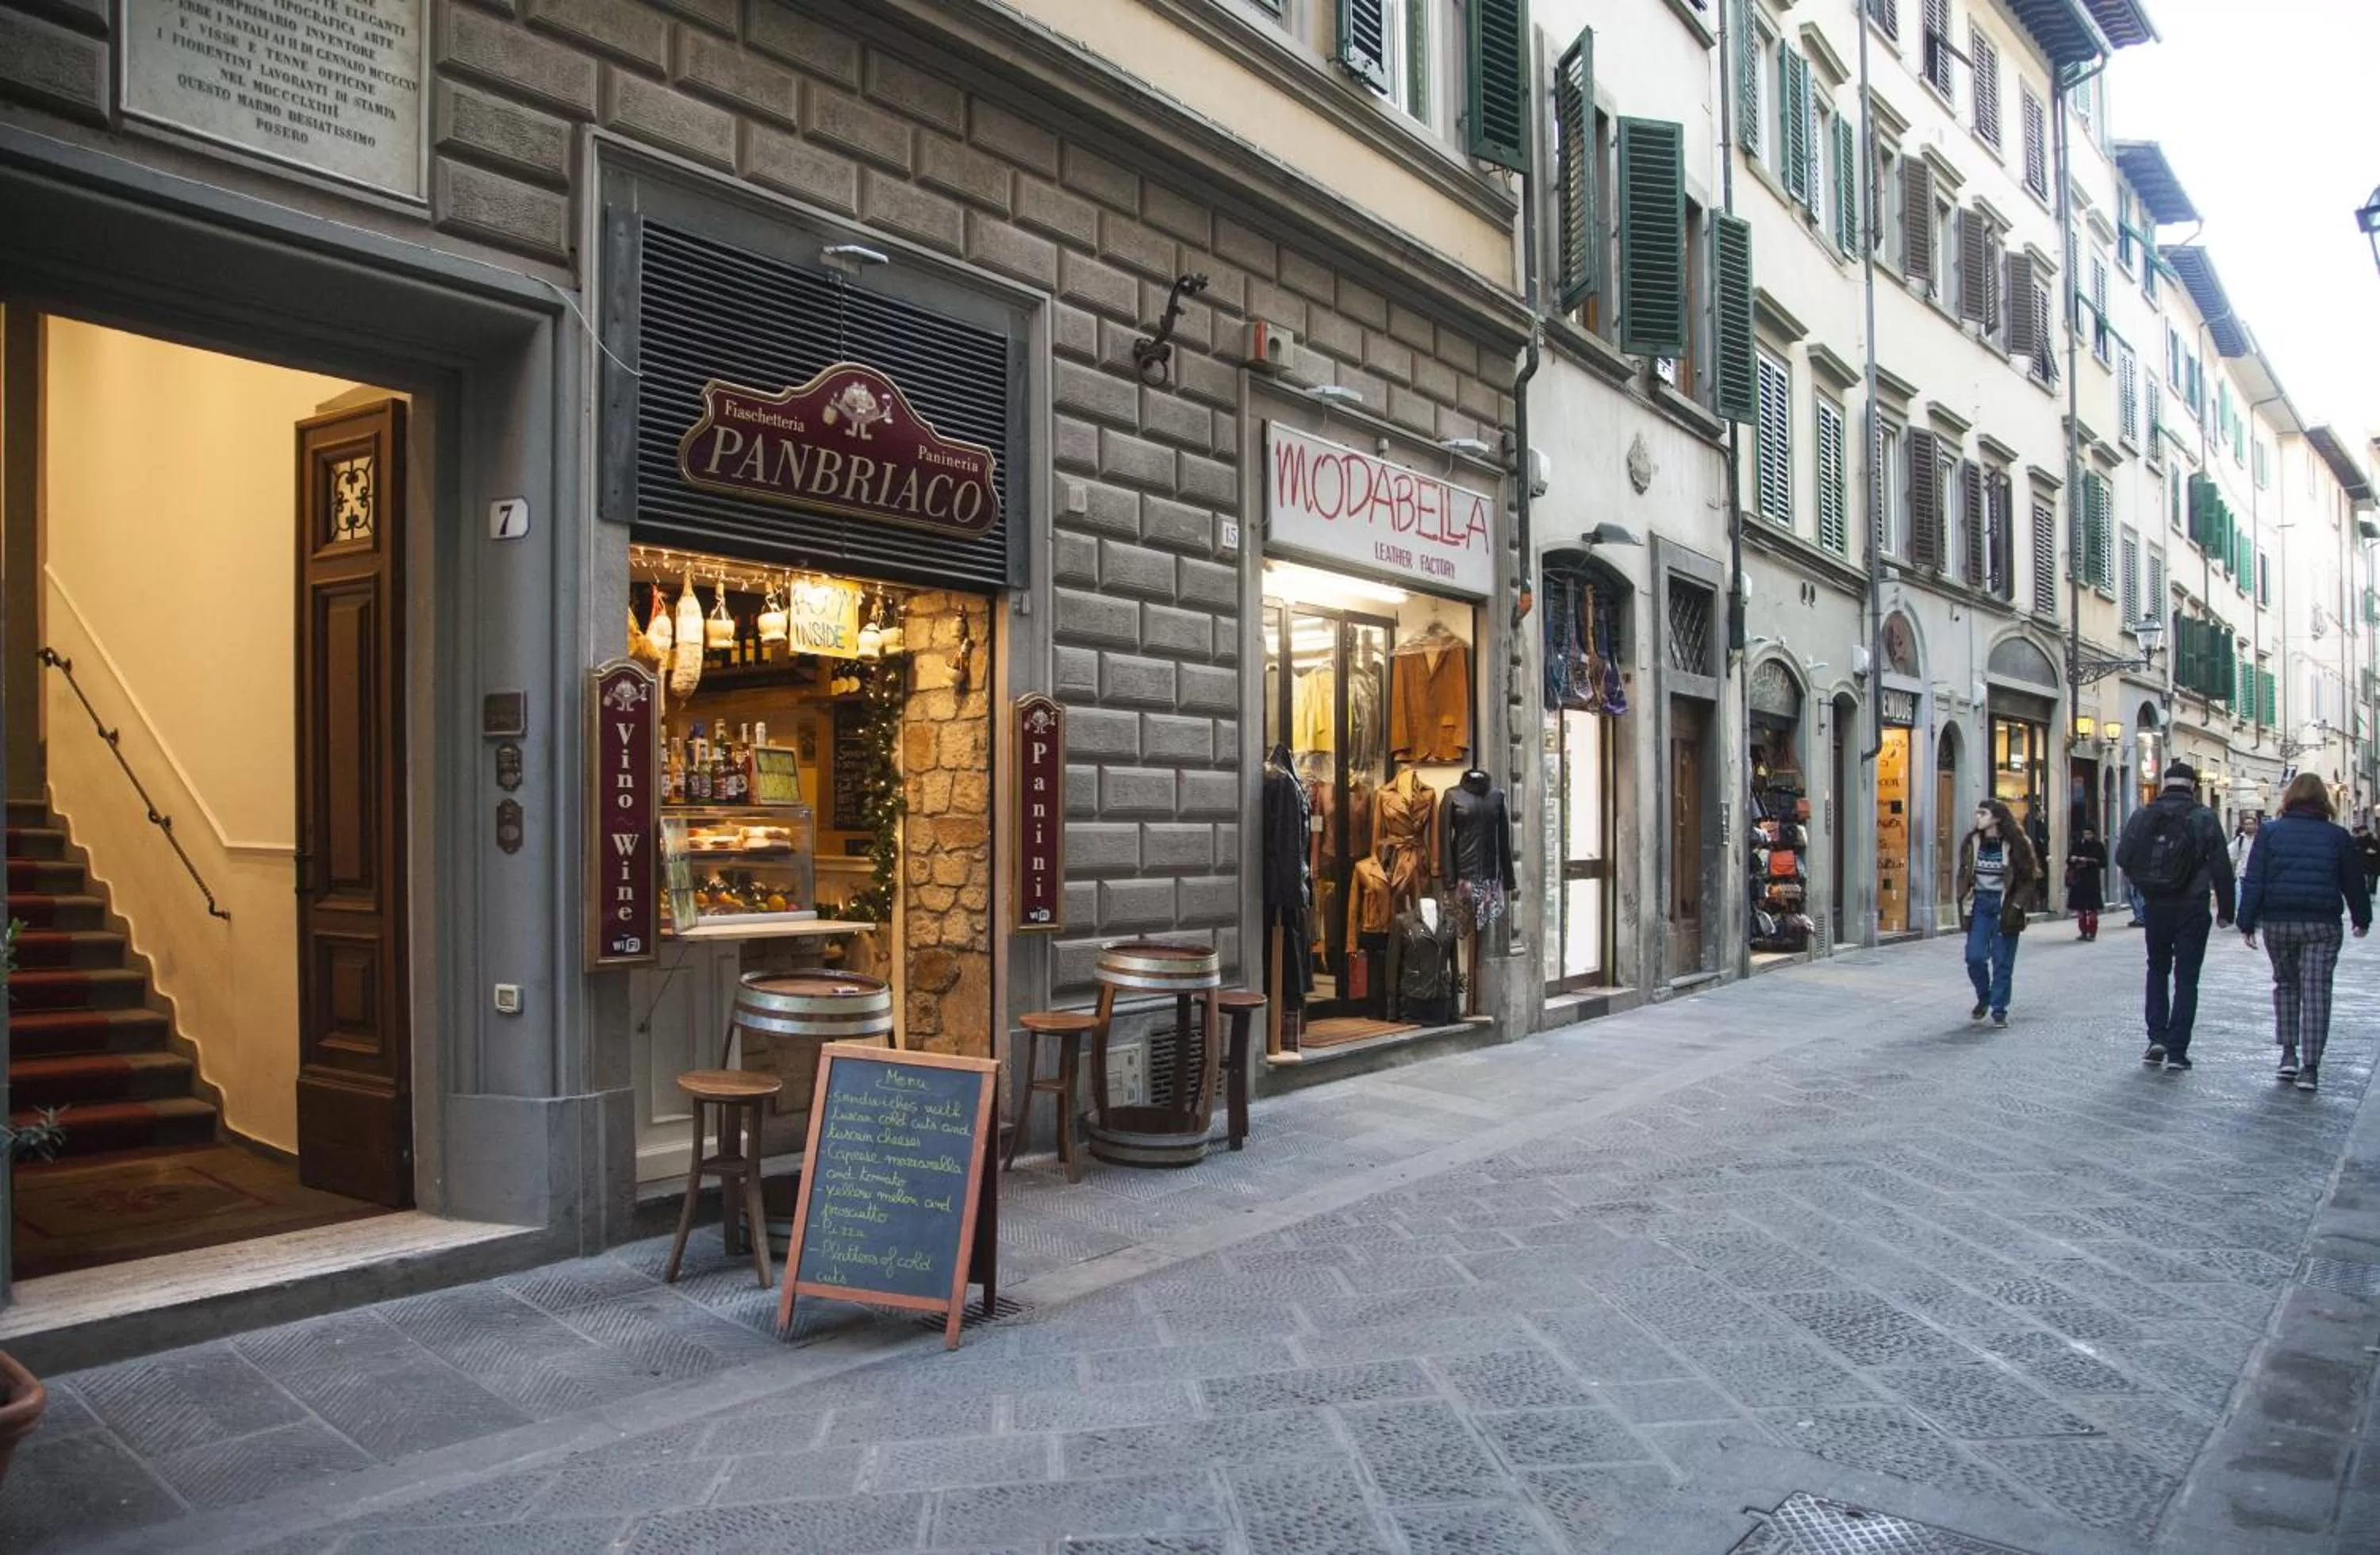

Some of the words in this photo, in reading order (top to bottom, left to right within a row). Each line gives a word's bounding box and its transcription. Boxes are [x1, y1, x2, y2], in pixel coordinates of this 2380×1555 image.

[345, 4, 405, 37] ELEGANTI
[226, 13, 269, 40] NATALI
[316, 48, 366, 75] GENNAIO
[305, 25, 376, 60] INVENTORE
[363, 31, 394, 50] ARTE
[199, 23, 237, 48] VISSE
[267, 48, 308, 71] TENNE
[318, 66, 376, 96] OFFICINE
[172, 32, 251, 71] FIORENTINI
[261, 63, 328, 96] LAVORANTI
[354, 97, 396, 121] STAMPA
[220, 68, 246, 87] NEL
[177, 73, 231, 101] QUESTO
[237, 93, 282, 117] MARMO
[255, 117, 309, 144] POSERO
[724, 399, 805, 433] Fiaschetteria
[704, 424, 983, 524] PANBRIACO
[918, 445, 978, 472] Panineria
[1275, 439, 1490, 555] MODABELLA
[498, 505, 514, 536] 7
[1375, 541, 1412, 570] LEATHER
[1419, 550, 1456, 579] FACTORY
[794, 620, 846, 650] INSIDE
[616, 722, 635, 808] Vino
[1031, 742, 1047, 898] Panini
[612, 833, 639, 921] Wine
[885, 1069, 930, 1091] Menu
[878, 1112, 906, 1127] cold
[911, 1117, 938, 1131] cuts
[941, 1123, 972, 1136] and
[924, 1104, 962, 1119] with
[826, 1166, 857, 1180] and
[859, 1165, 908, 1187] tomato
[877, 1186, 919, 1208] melon
[924, 1196, 953, 1213] and
[816, 1265, 848, 1284] cuts
[881, 1246, 898, 1278] of
[897, 1250, 932, 1270] cold
